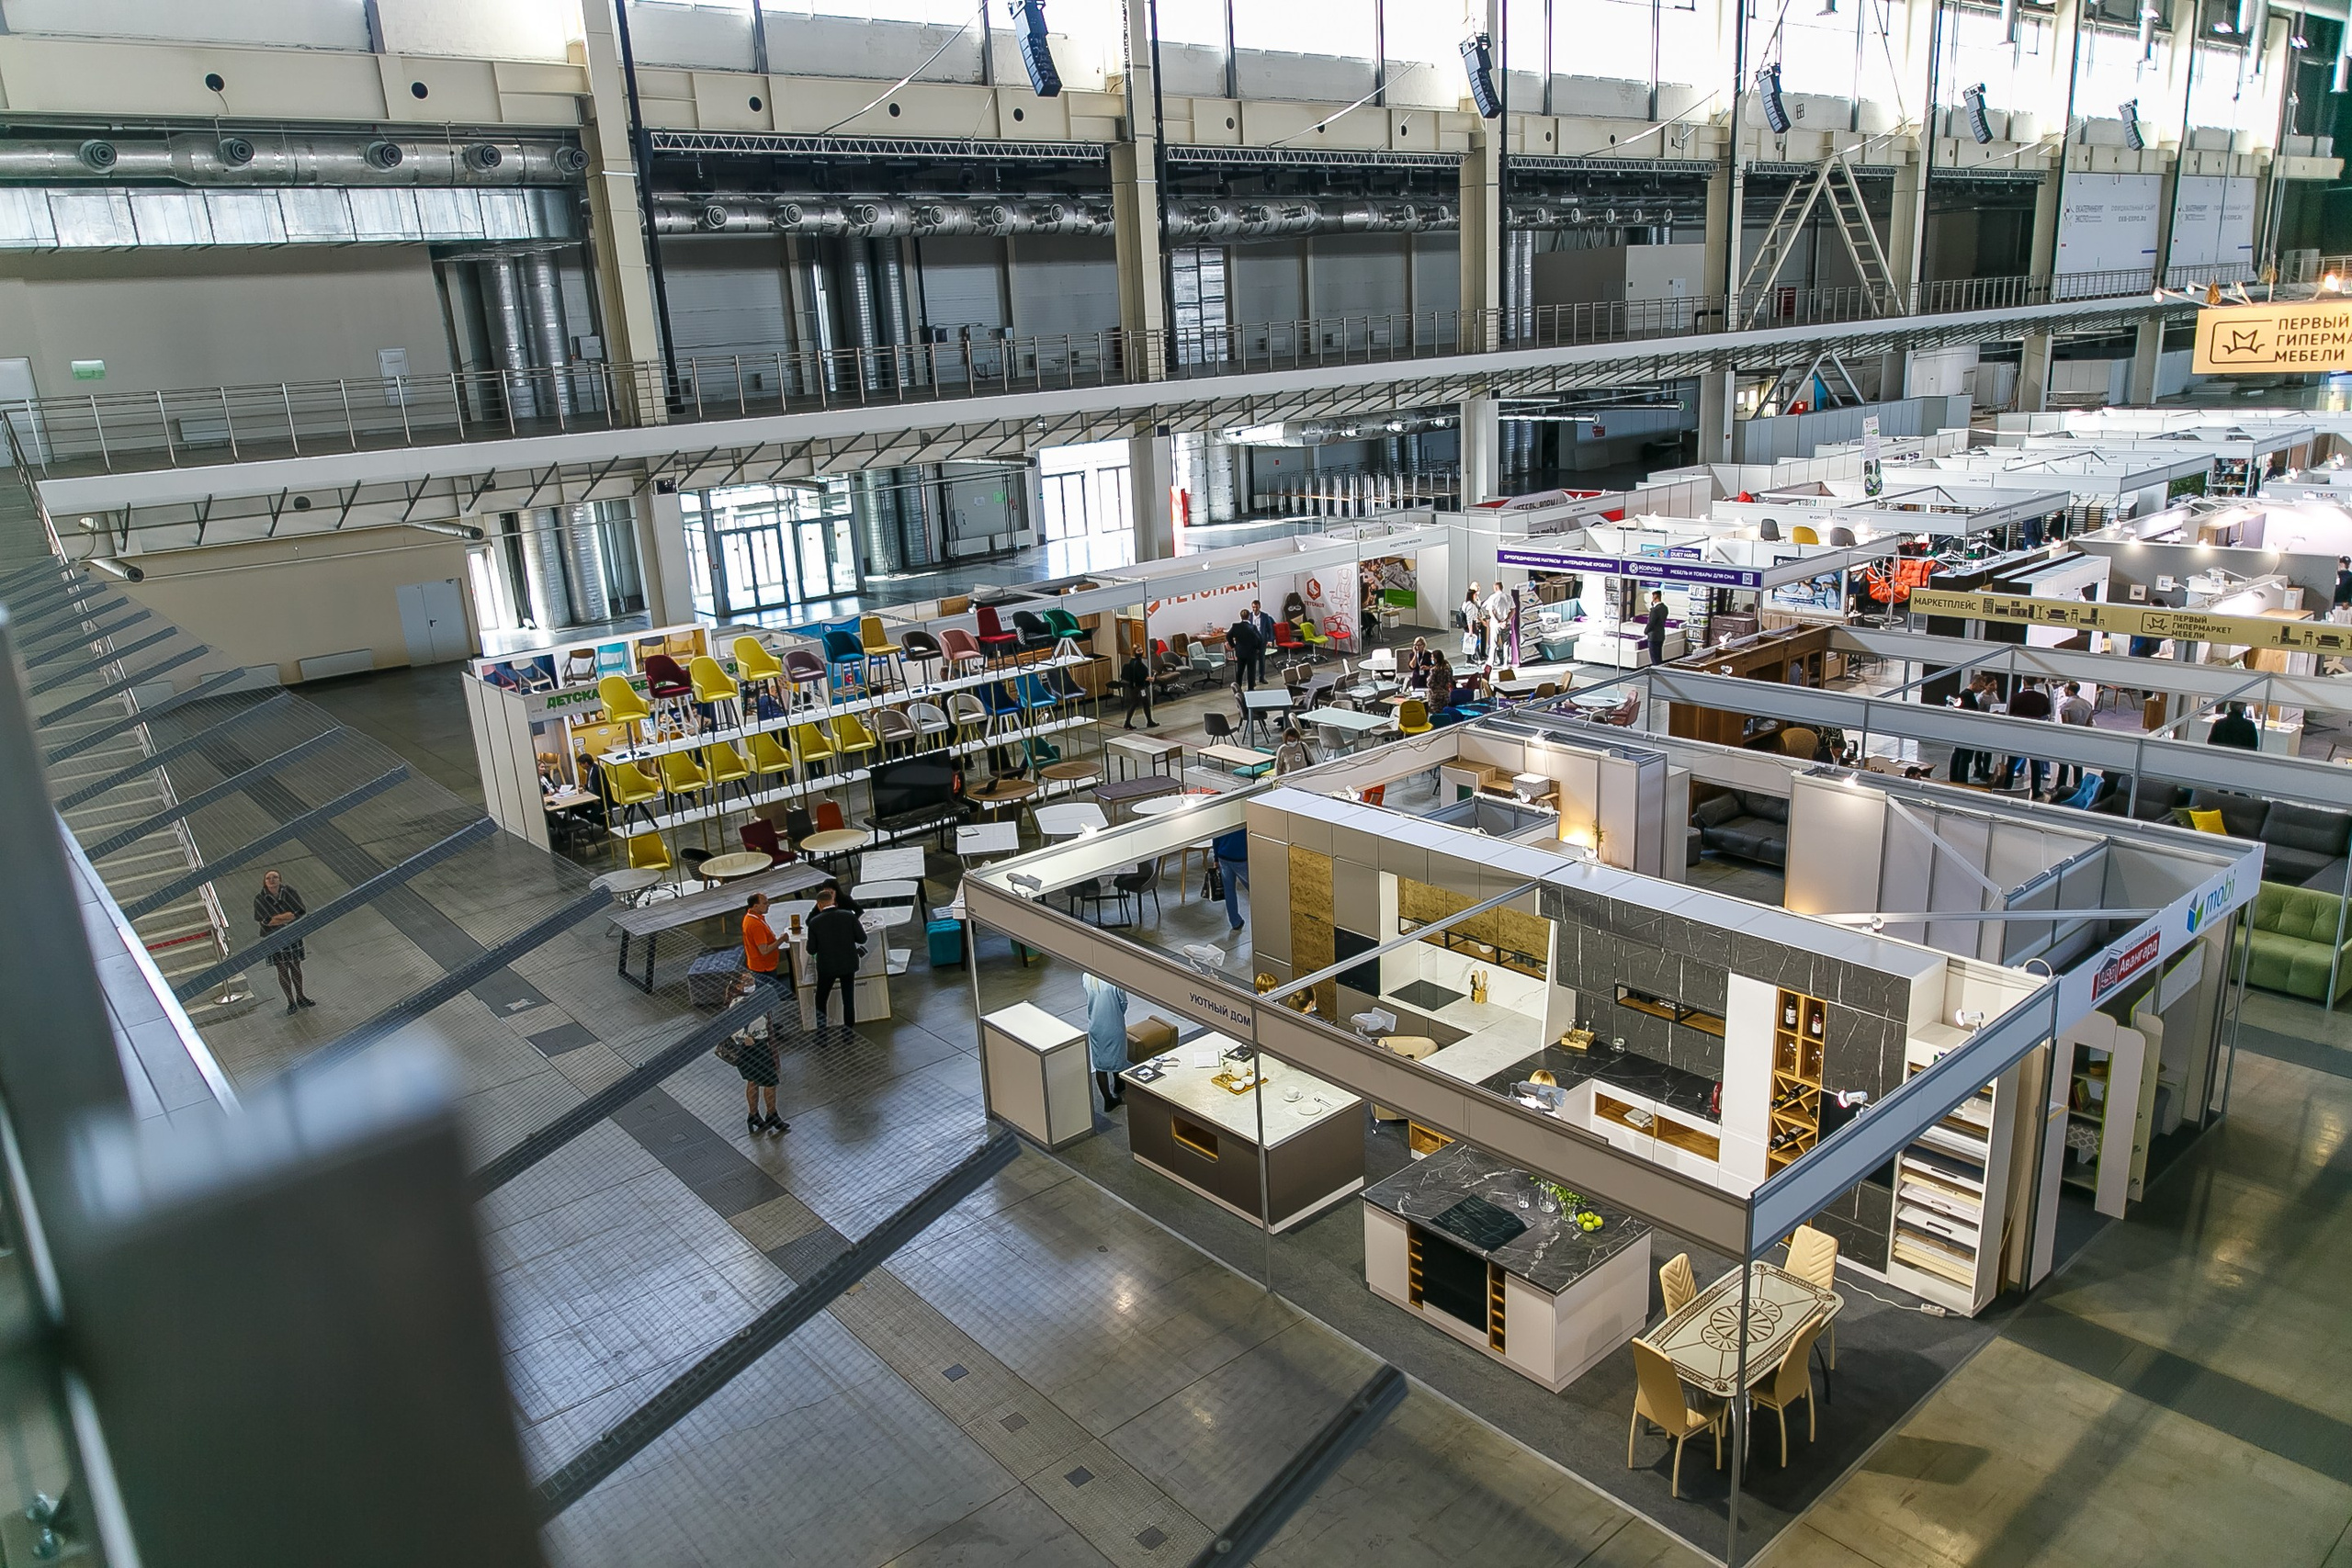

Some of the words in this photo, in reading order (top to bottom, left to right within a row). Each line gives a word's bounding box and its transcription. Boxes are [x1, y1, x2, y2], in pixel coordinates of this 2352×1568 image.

[2278, 312, 2349, 331] ПЕРВЫЙ
[2275, 349, 2346, 363] МЕБЕЛИ
[1693, 570, 1713, 579] ТОВАРЫ
[1305, 600, 1325, 608] TETCHAIR
[1914, 596, 1977, 611] МАРКЕТПЛЕЙС
[2173, 614, 2208, 624] ПЕРВЫЙ
[2171, 630, 2206, 639] МЕБЕЛИ
[2172, 622, 2232, 635] ГИПЕРМАРКЕТ
[547, 688, 600, 709] ДЕТСКА
[2205, 869, 2236, 915] mobi
[2119, 939, 2158, 976] Авангард
[1189, 992, 1228, 1017] УЮТНЫЙ
[1230, 1010, 1251, 1027] ДОМ
